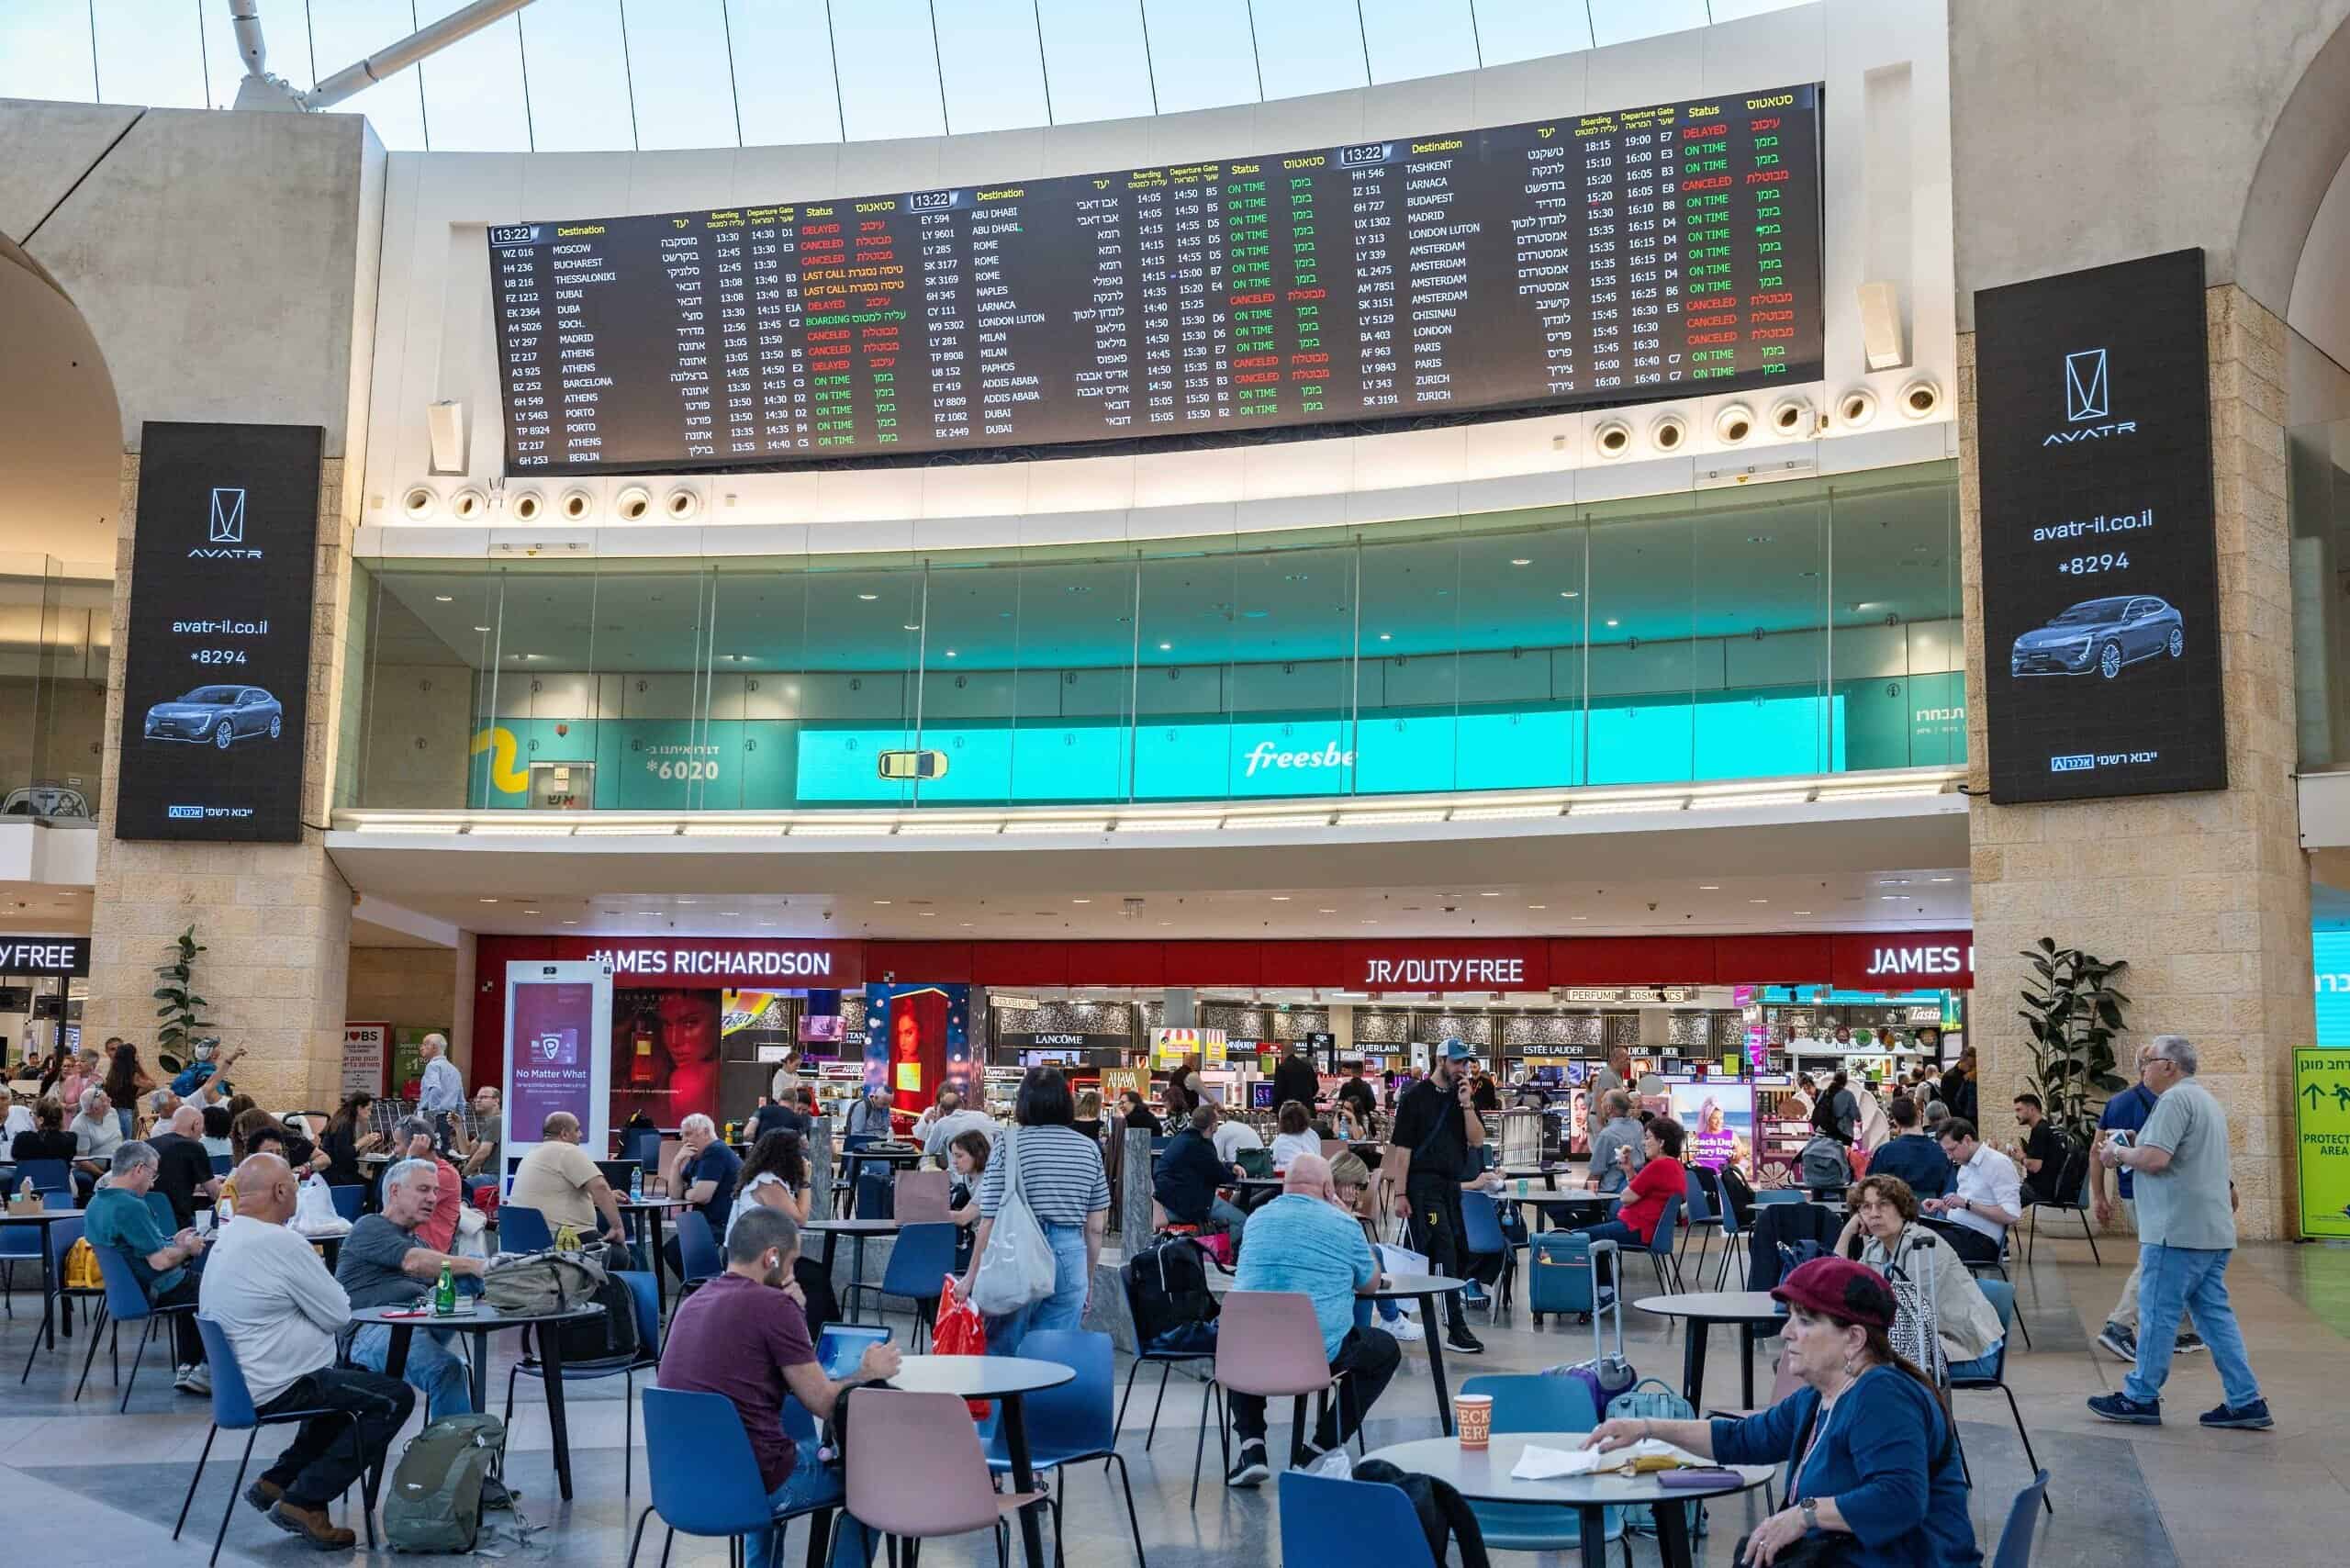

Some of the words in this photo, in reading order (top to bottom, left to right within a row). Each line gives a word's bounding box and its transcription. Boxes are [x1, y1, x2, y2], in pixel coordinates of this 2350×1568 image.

[1581, 115, 1611, 127] Boarding
[1621, 108, 1655, 121] Departure
[1657, 106, 1673, 116] Gate
[1658, 117, 1673, 125] שער
[1347, 146, 1380, 162] 13:22
[1412, 139, 1461, 153] Destination
[1538, 127, 1556, 138] יעד
[1688, 104, 1719, 118] Status
[1746, 94, 1793, 110] סטאטוס
[1601, 124, 1617, 133] עליה
[1626, 120, 1651, 129] המראה
[1575, 127, 1599, 136] למטוס
[1133, 170, 1160, 180] Boarding
[1169, 165, 1201, 176] Departure
[1203, 163, 1218, 172] Gate
[915, 193, 947, 207] 13:22
[977, 187, 1024, 201] Destination
[1093, 179, 1109, 189] יעד
[1231, 163, 1259, 174] Status
[1283, 156, 1325, 169] סטאטוס
[1353, 202, 1366, 212] 6H
[1368, 200, 1384, 211] 727
[1407, 193, 1454, 206] BUDAPEST
[1525, 181, 1565, 193] בודפשט
[1586, 174, 1612, 185] 15:20
[1627, 168, 1651, 180] 16:05
[1661, 166, 1673, 176] B3
[1685, 162, 1699, 173] ON
[1703, 159, 1727, 170] TIME
[1755, 154, 1778, 166] בזמן
[1355, 218, 1367, 229] UX
[1370, 217, 1391, 227] 1302
[1408, 210, 1444, 223] MADRID
[1535, 197, 1565, 208] מדריד
[1587, 191, 1612, 202] 15:20
[1628, 185, 1652, 197] 16:05
[1662, 183, 1673, 193] E8
[1682, 176, 1731, 190] CANCELED
[1746, 170, 1788, 183] מבוטלת
[711, 210, 739, 219] Boarding
[747, 207, 778, 217] Departure
[778, 206, 793, 214] Gate
[497, 228, 528, 241] 13:22
[557, 224, 605, 236] Destination
[673, 218, 688, 228] יעד
[806, 207, 834, 217] Status
[856, 201, 895, 212] סטאטוס
[923, 246, 933, 255] LY
[935, 244, 951, 253] 285
[973, 240, 998, 250] ROME
[1097, 230, 1119, 239] רומא
[1139, 224, 1162, 234] 14:15
[1176, 220, 1199, 230] 14:55
[1207, 218, 1219, 228] D5
[1229, 217, 1242, 225] ON
[1245, 213, 1266, 223] TIME
[1292, 210, 1313, 220] בזמן
[502, 249, 516, 257] WZ
[518, 248, 533, 256] 016
[553, 243, 590, 254] MOSCOW
[661, 237, 697, 247] מוסקבה
[716, 232, 738, 241] 13:30
[752, 230, 774, 239] 14:30
[781, 228, 792, 237] D1
[802, 224, 839, 234] DELAYED
[861, 220, 884, 230] עיכוב
[806, 314, 849, 325] BOARDING
[851, 311, 881, 322] למטוס
[884, 309, 905, 319] עליה
[723, 322, 745, 332] 12:56
[758, 319, 780, 330] 13:45
[789, 319, 800, 327] C2
[929, 337, 939, 346] LY
[942, 336, 957, 345] 281
[979, 331, 1005, 342] MILAN
[1095, 321, 1125, 333] מילאנו
[1145, 318, 1168, 328] 14:50
[1181, 315, 1204, 325] 15:30
[1212, 313, 1225, 322] D6
[1235, 311, 1248, 319] ON
[1249, 308, 1271, 319] TIME
[1296, 306, 1317, 317] בזמן
[676, 327, 704, 336] מדריד
[509, 338, 520, 346] LY
[521, 337, 537, 346] 297
[559, 333, 593, 343] MADRID
[1362, 380, 1372, 389] LY
[1376, 378, 1391, 387] 343
[1416, 374, 1449, 385] ZURICH
[1547, 364, 1572, 376] ציריך
[1595, 359, 1618, 369] 16:00
[1634, 355, 1659, 366] 16:40
[1668, 353, 1680, 363] C7
[1692, 352, 1706, 361] ON
[1709, 349, 1733, 359] TIME
[1762, 346, 1785, 357] בזמן
[2043, 421, 2136, 447] AVATR
[2033, 509, 2153, 542] avatr-il.co.il
[187, 548, 263, 559] AVATR
[173, 620, 268, 634] avatr-il.co.il
[2097, 754, 2127, 766] רשמי
[2131, 751, 2157, 763] ייבוא
[206, 808, 229, 816] רשמי
[231, 808, 252, 816] ייבוא
[674, 951, 831, 975] RICHARDSON
[1866, 946, 1961, 974] JAMES
[1629, 991, 1682, 1001] COSMICS
[1035, 1034, 1082, 1045] LANCÔME
[1355, 1044, 1400, 1053] GUERLAIN
[1549, 1046, 1583, 1054] LAUDER
[1628, 1047, 1649, 1056] DIOR
[1662, 1047, 1679, 1056] DIOR
[516, 1070, 530, 1078] No
[532, 1070, 559, 1078] Matter
[563, 1070, 587, 1079] What
[2321, 1146, 2349, 1155] AREA
